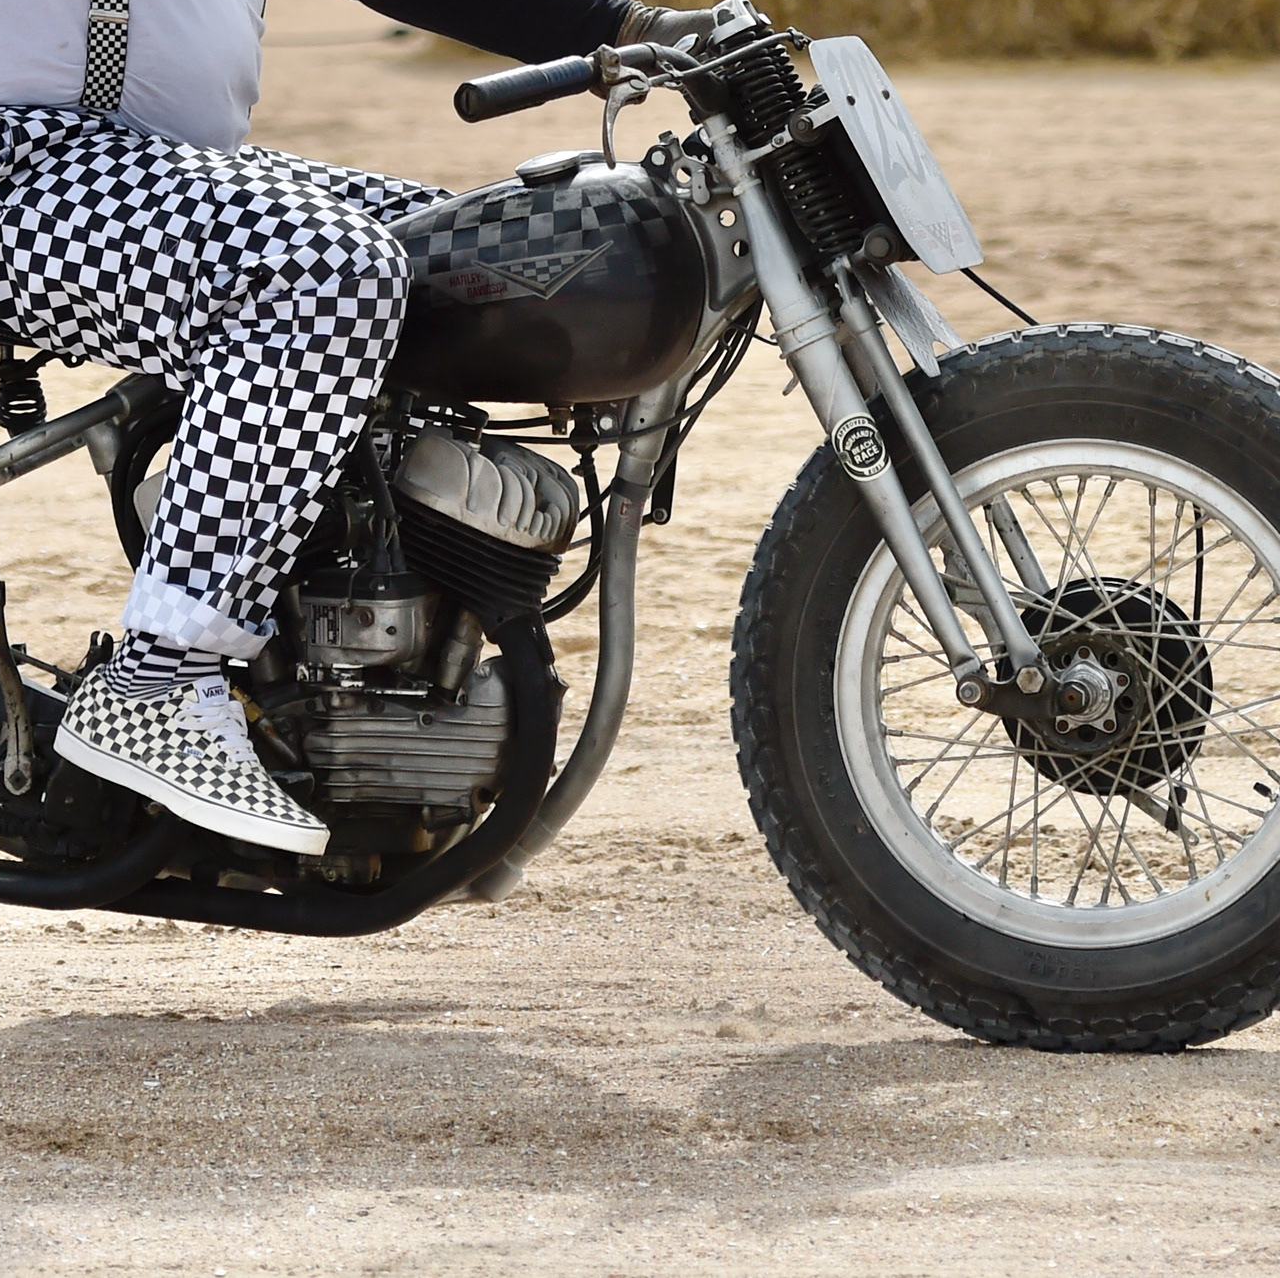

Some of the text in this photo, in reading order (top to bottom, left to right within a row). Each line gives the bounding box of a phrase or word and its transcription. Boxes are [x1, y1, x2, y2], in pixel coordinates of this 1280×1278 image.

[466, 282, 508, 299] DAVIDSON
[838, 419, 867, 438] APPROVED
[845, 429, 874, 451] NORMANDY
[851, 439, 874, 456] BEACH
[853, 444, 880, 464] RACE
[202, 685, 225, 699] VANS
